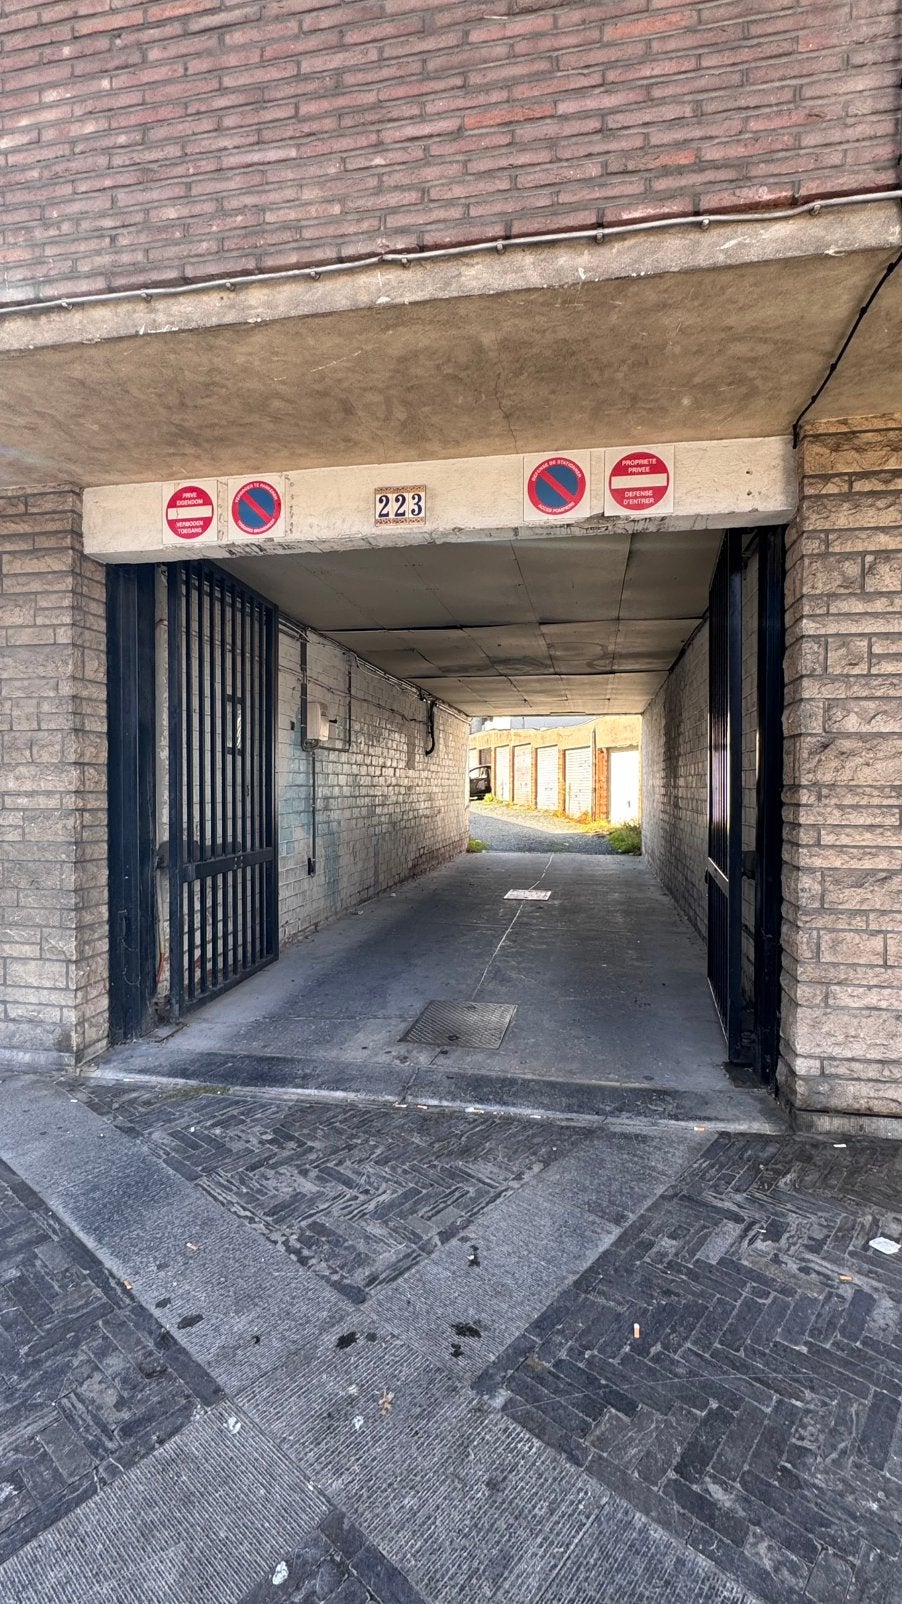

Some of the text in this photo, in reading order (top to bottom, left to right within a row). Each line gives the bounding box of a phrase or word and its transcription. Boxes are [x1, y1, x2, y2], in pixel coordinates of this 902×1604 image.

[622, 458, 657, 466] PROPRIETE
[623, 497, 655, 505] D'ENTRER
[378, 493, 422, 518] 223
[176, 520, 203, 528] VERBODEN
